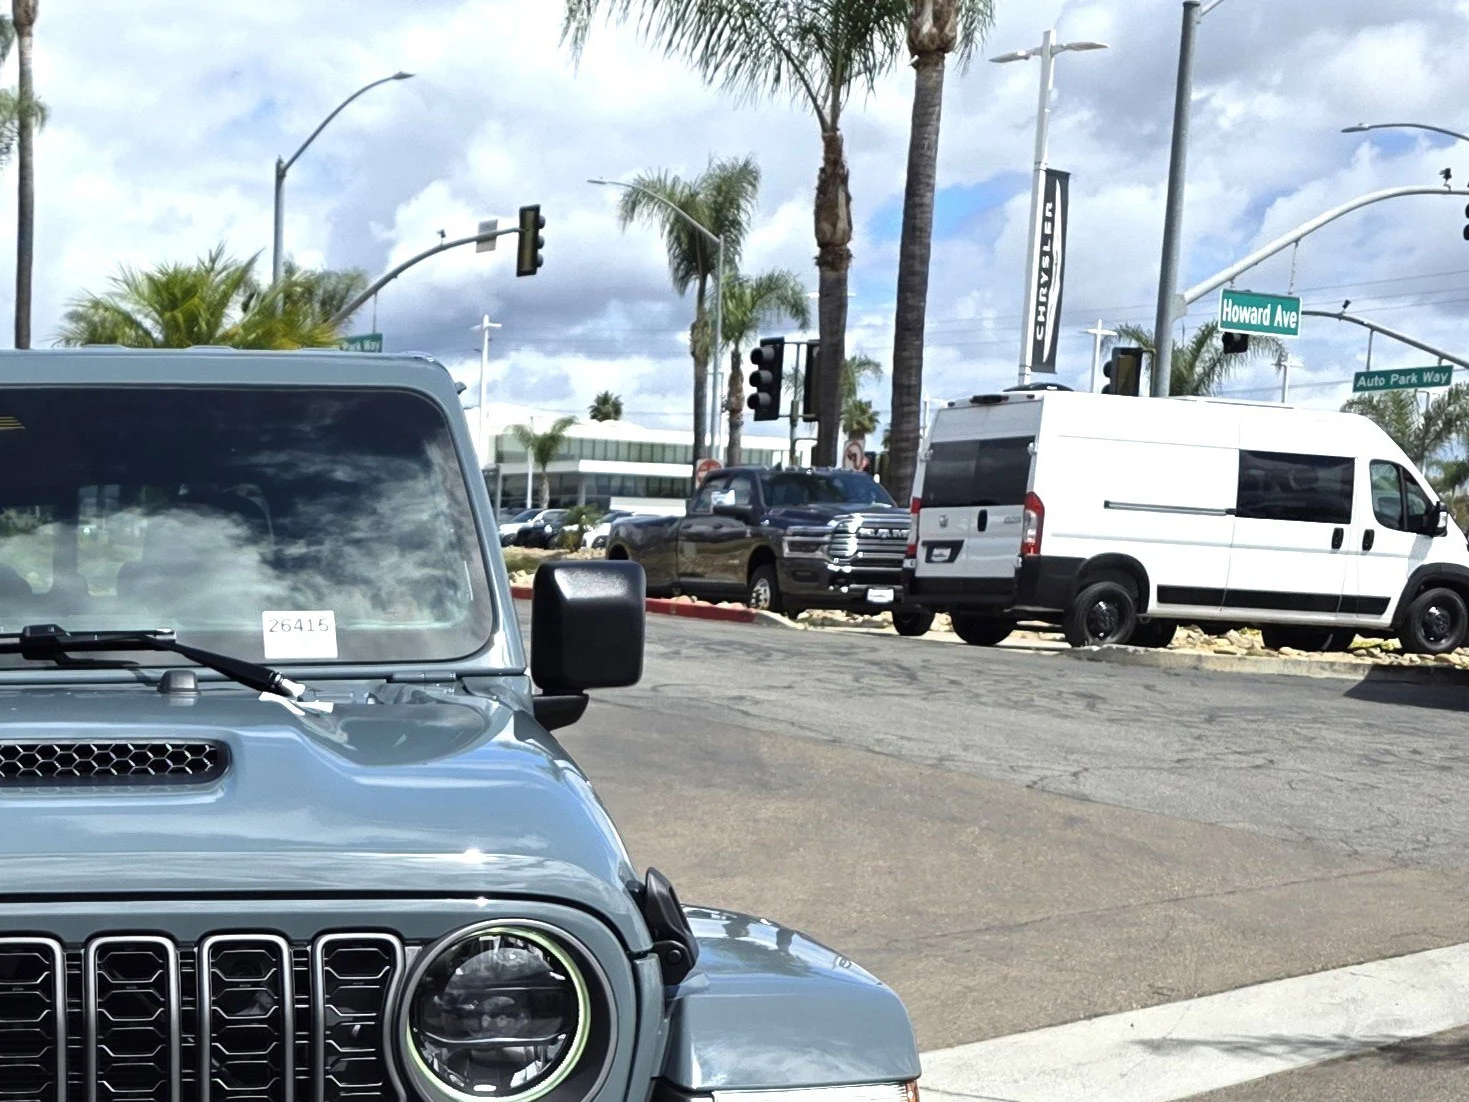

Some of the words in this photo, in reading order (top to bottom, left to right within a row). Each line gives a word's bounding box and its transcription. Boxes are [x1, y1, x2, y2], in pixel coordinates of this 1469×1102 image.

[1036, 201, 1053, 341] CHRYSLER
[1222, 298, 1271, 326] Howard
[1274, 304, 1297, 328] Ave
[1356, 375, 1385, 387] Auto
[1390, 373, 1418, 385] Park
[1423, 371, 1448, 384] Way
[858, 527, 911, 539] RAM
[269, 619, 329, 632] 26415
